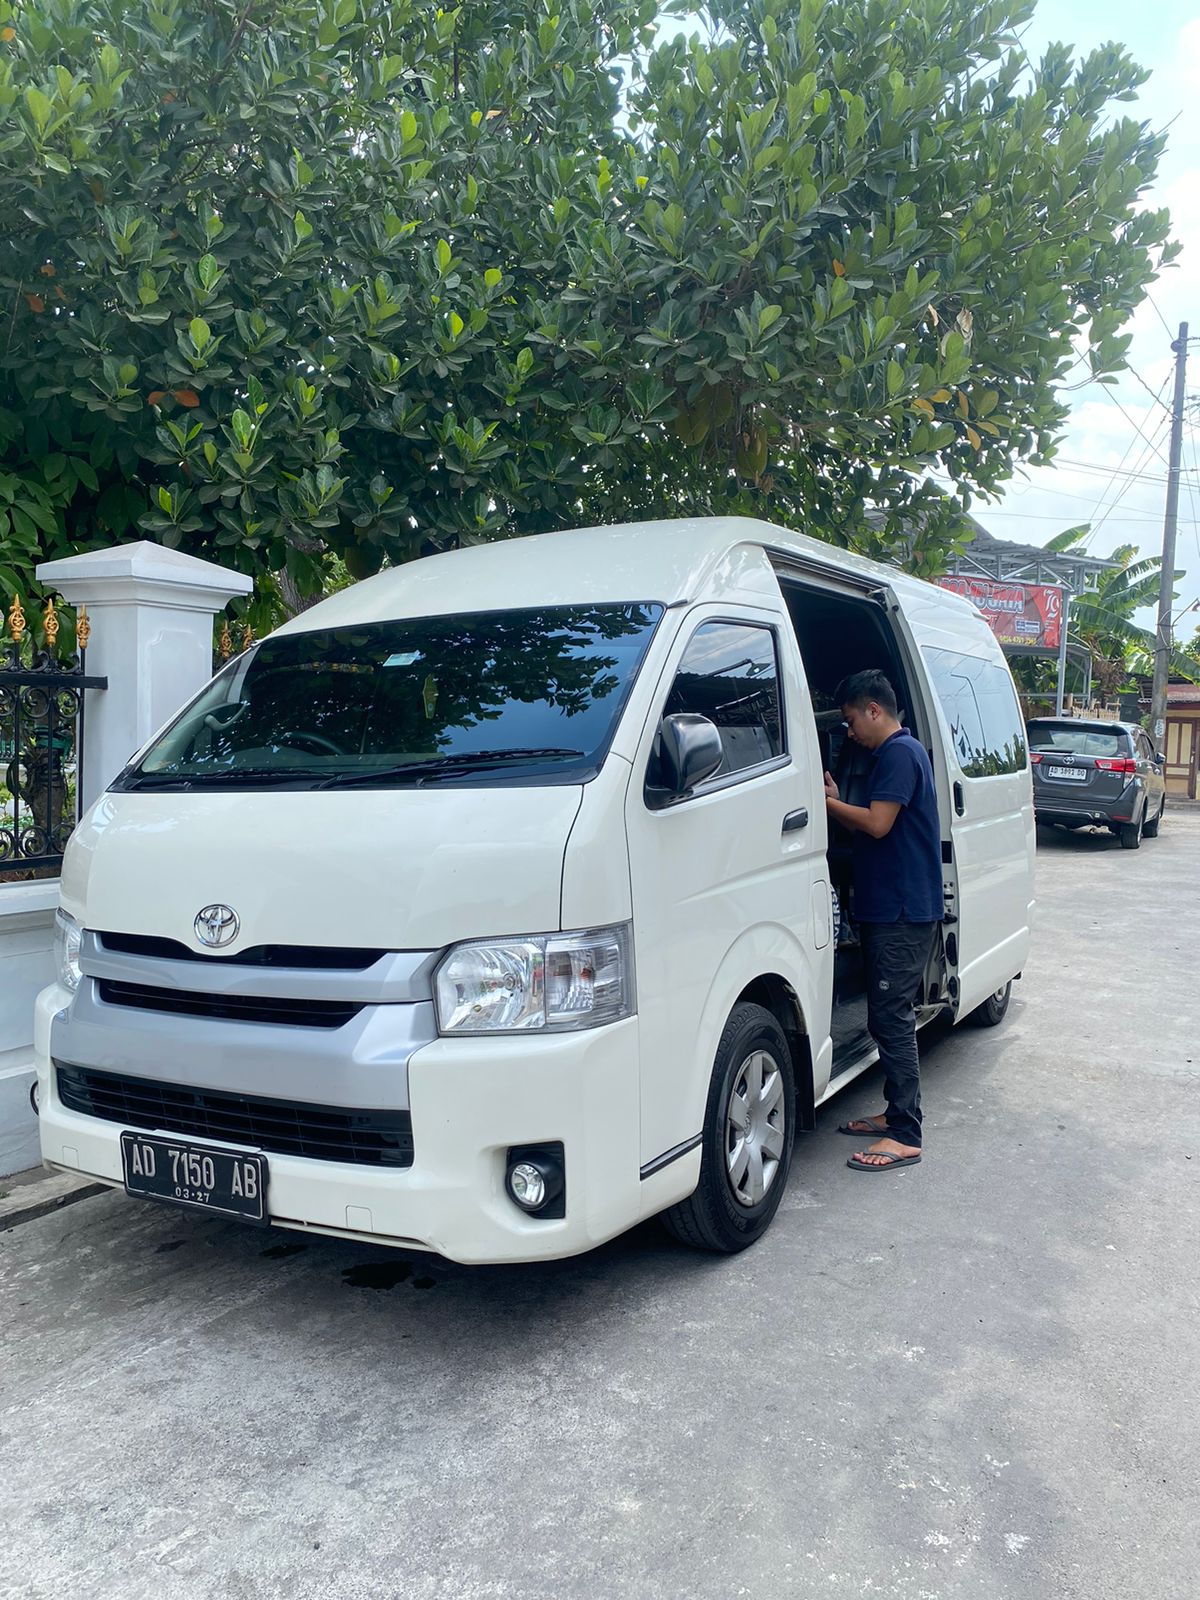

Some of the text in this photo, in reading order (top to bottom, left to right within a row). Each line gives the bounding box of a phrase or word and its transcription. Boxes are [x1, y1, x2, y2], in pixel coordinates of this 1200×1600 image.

[132, 1143, 258, 1199] AD 7150 AB
